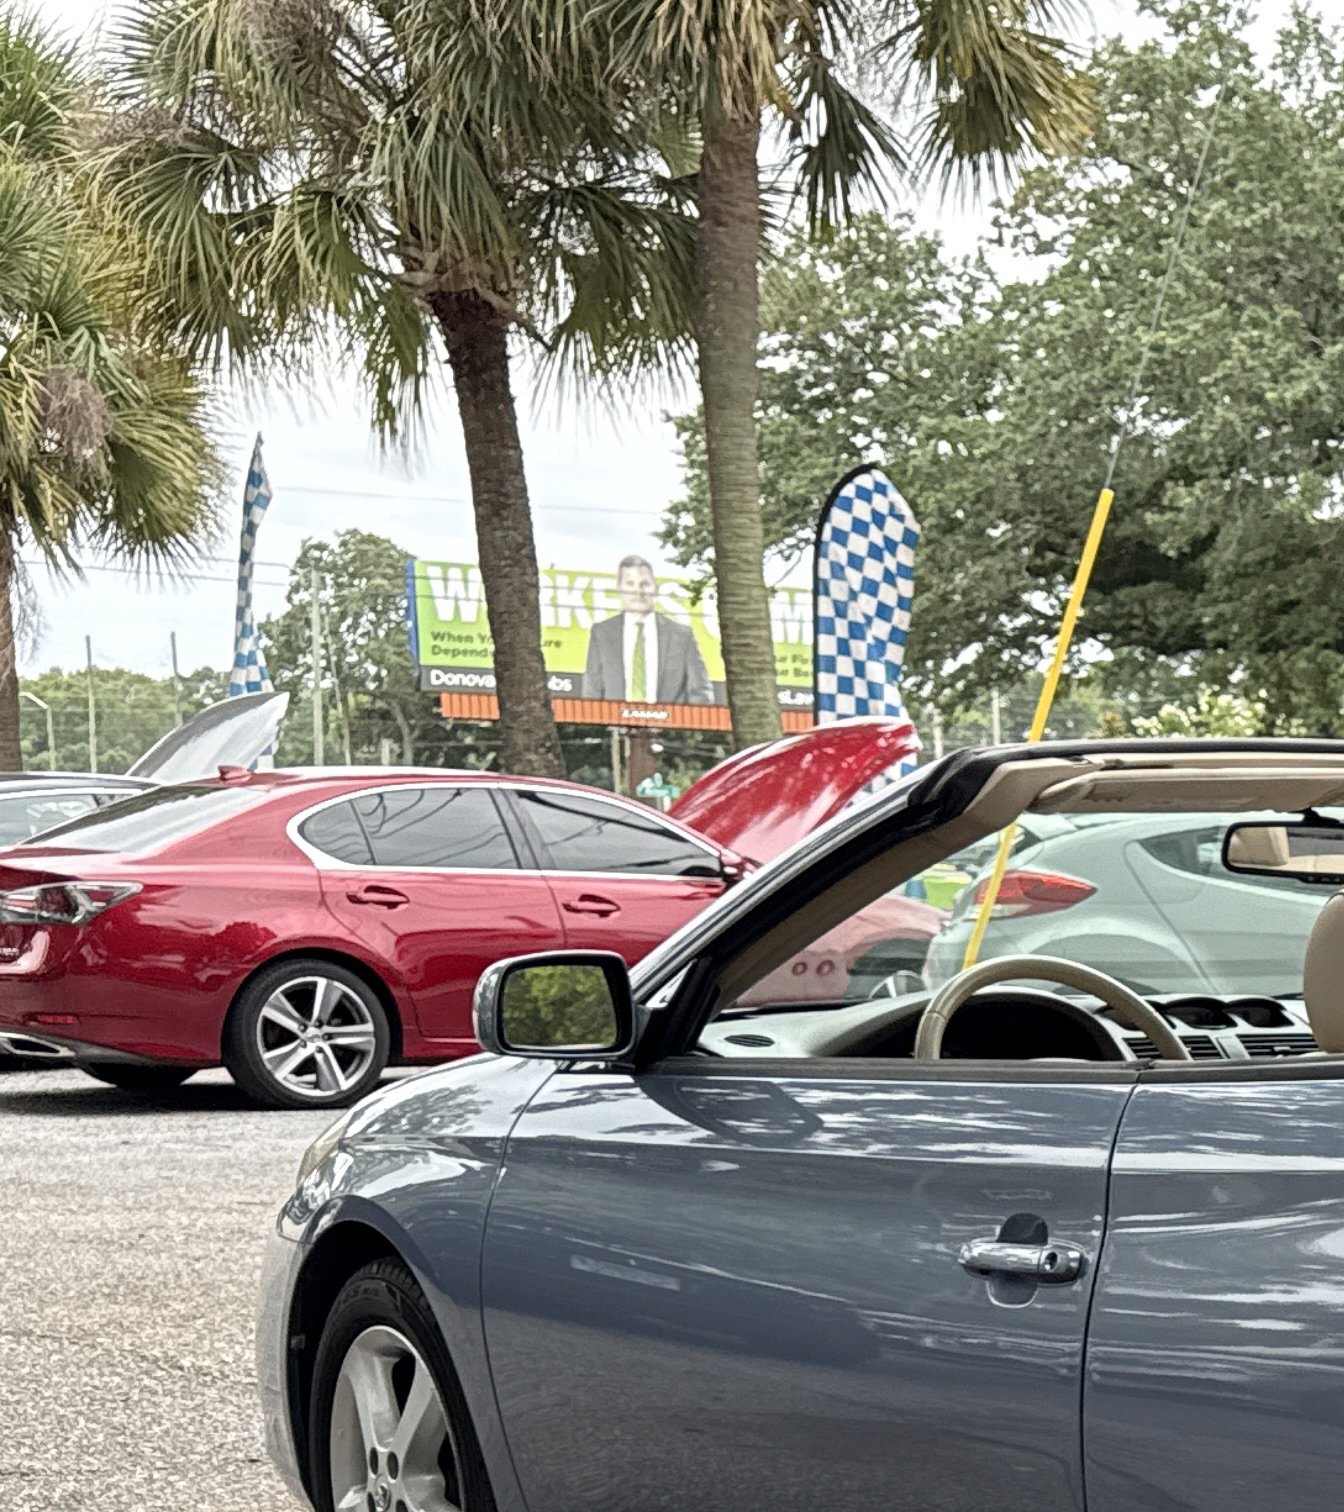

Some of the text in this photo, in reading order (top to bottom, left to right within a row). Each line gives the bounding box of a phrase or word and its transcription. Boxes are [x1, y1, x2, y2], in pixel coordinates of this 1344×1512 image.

[430, 631, 474, 644] When
[431, 645, 495, 659] Depend
[430, 668, 496, 688] Donova
